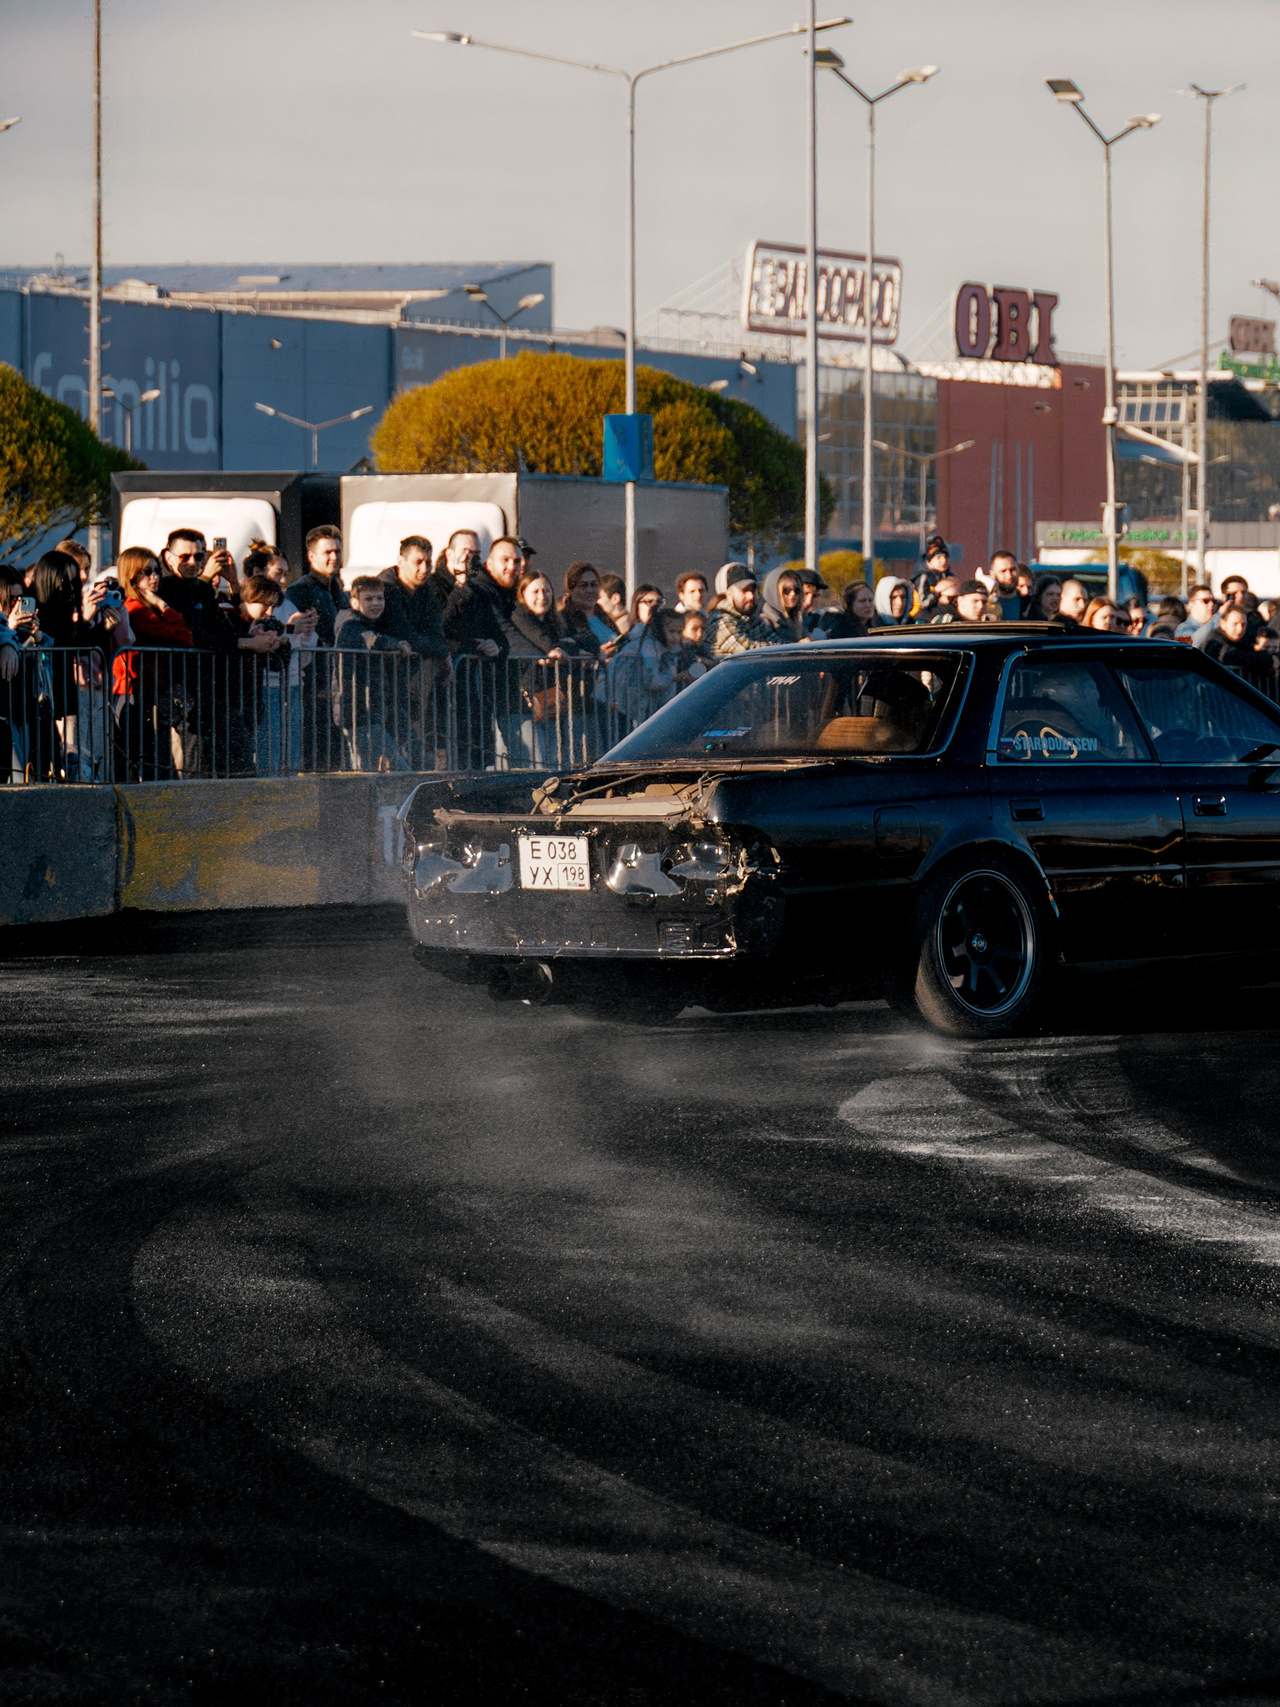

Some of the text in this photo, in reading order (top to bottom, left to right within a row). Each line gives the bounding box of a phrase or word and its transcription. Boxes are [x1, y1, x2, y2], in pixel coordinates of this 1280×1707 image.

[955, 282, 1059, 367] OBI
[547, 841, 577, 860] 038
[562, 866, 585, 881] 198
